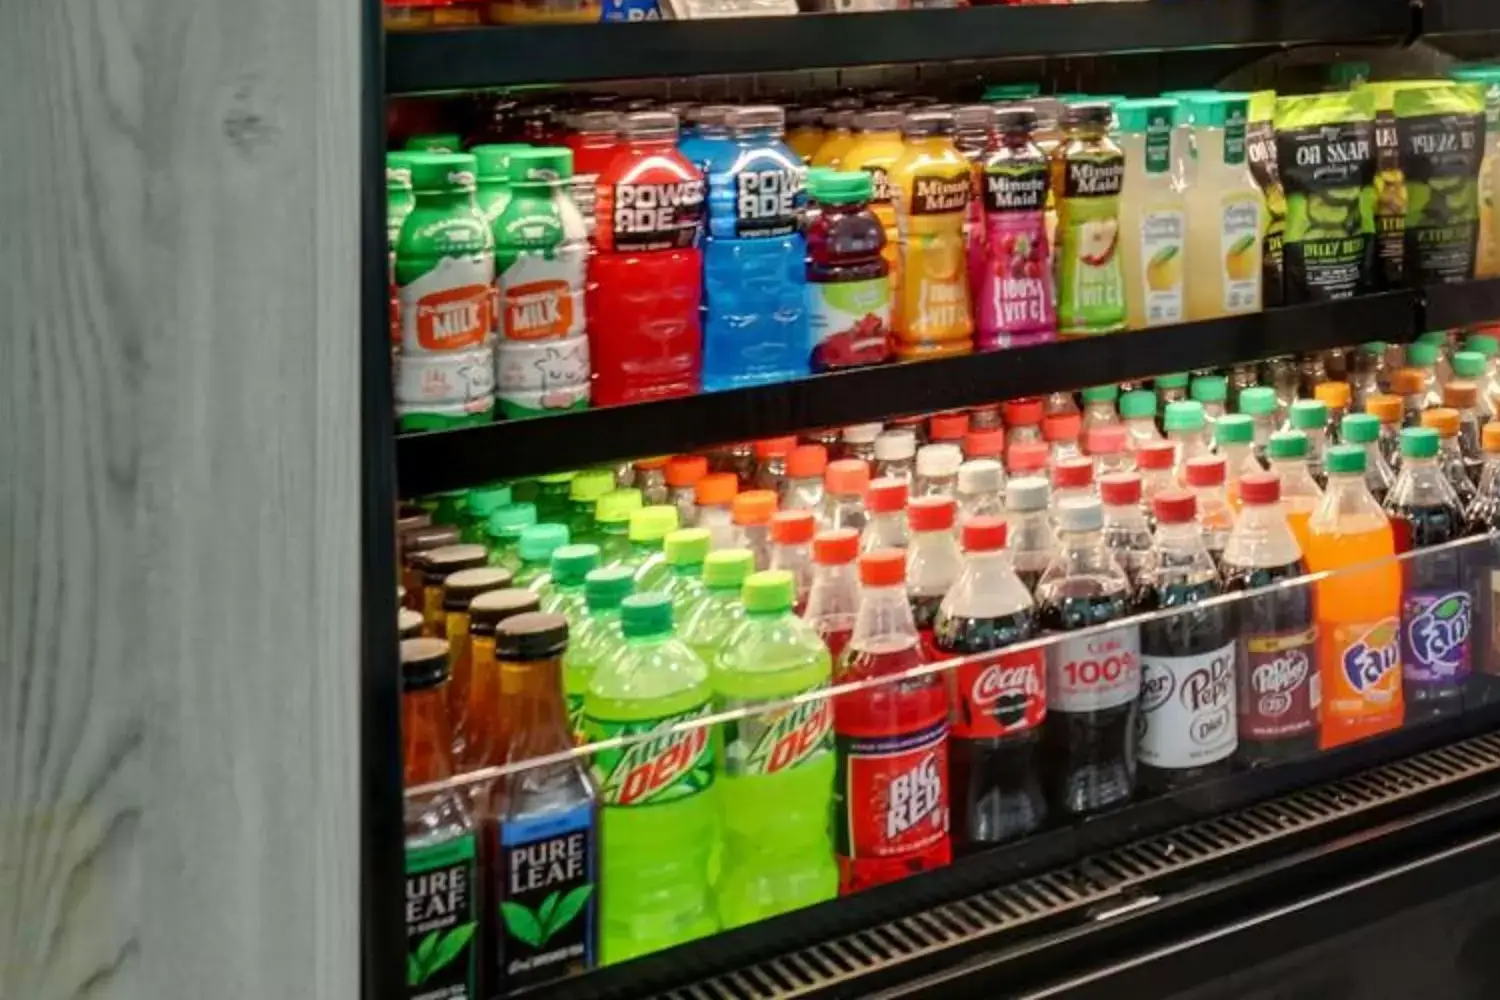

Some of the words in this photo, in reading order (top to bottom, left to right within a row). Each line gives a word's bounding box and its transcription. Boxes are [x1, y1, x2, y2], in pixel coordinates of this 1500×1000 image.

[988, 176, 1044, 193] Minute
[1071, 163, 1124, 180] Minute
[1077, 176, 1118, 193] Maid
[616, 181, 704, 208] POWE
[738, 192, 793, 218] ADE
[996, 190, 1037, 208] Maid
[614, 208, 674, 232] ADE
[433, 302, 480, 340] MILK
[511, 295, 559, 331] MILK
[889, 751, 937, 804] BIG
[887, 776, 941, 839] RED
[511, 834, 584, 872] PURE
[405, 866, 466, 898] URE
[405, 889, 465, 922] EAF
